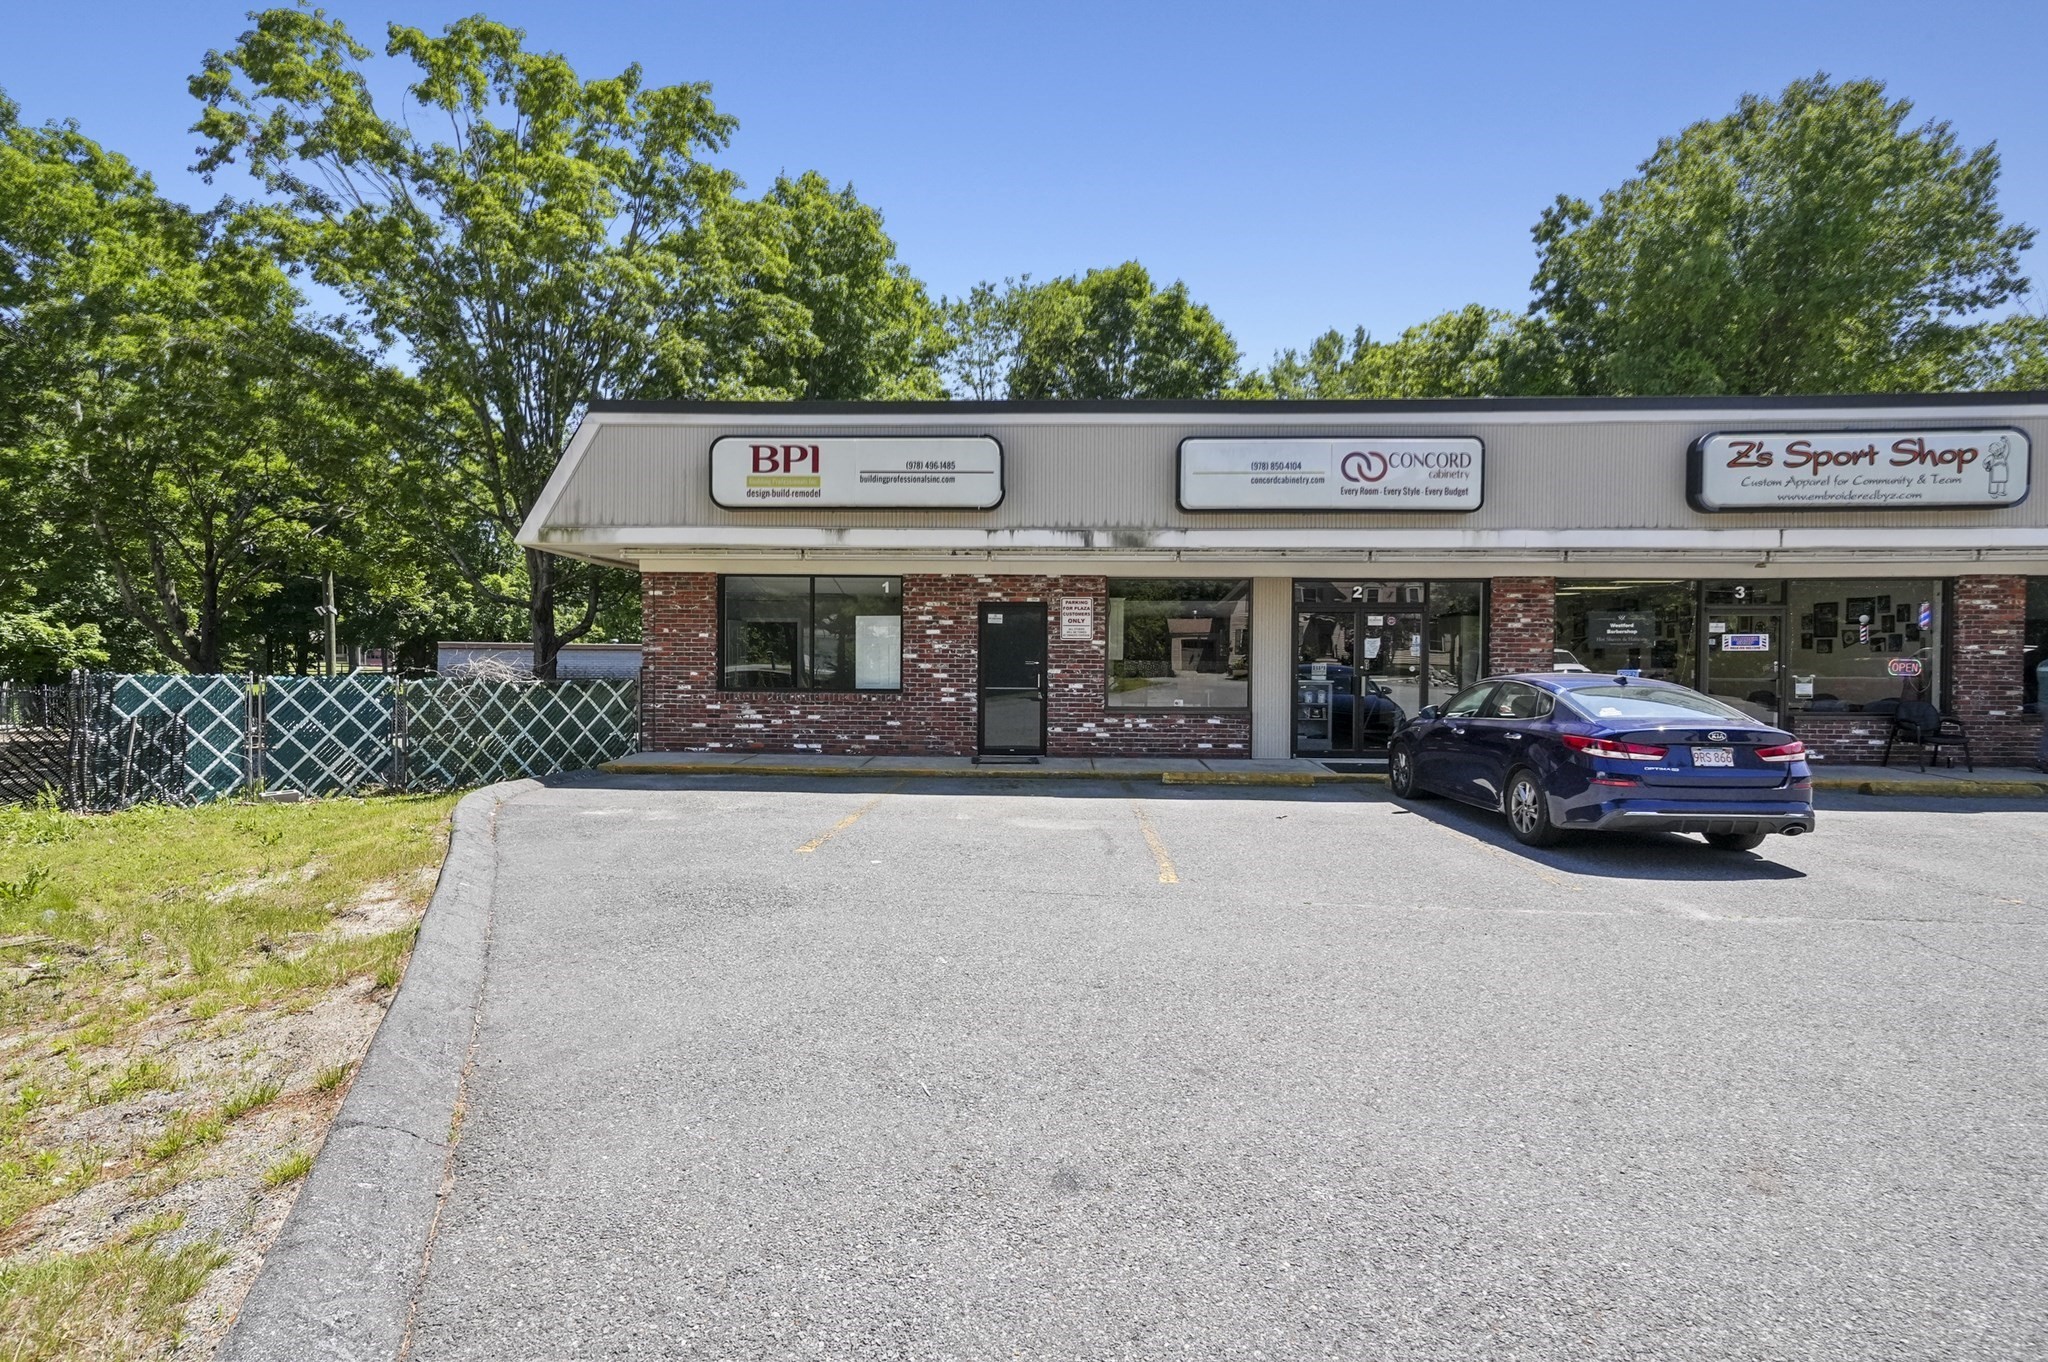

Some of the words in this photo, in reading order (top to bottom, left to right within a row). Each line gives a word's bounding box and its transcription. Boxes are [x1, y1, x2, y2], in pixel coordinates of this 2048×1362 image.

[748, 444, 820, 474] BPI
[1388, 451, 1472, 469] CONCORD
[1726, 440, 1774, 469] Z's
[1783, 440, 1879, 476] Sport
[1889, 437, 1979, 474] Shop
[905, 460, 924, 471] (978)
[1250, 461, 1269, 472] (978)
[859, 475, 956, 485] buildingprofessionalsinc.com
[1250, 475, 1325, 486] concordcabinetry.com
[1428, 469, 1470, 481] cabinetry
[1740, 476, 1782, 488] Custom
[1784, 475, 1831, 489] Apparel
[1833, 474, 1849, 488] for
[1852, 474, 1913, 487] Community
[1916, 475, 1928, 485] &
[1930, 473, 1963, 485] Team
[1340, 486, 1358, 497] Every
[1359, 486, 1379, 496] Room
[1383, 486, 1401, 497] Every
[1402, 486, 1421, 497] Style
[1424, 487, 1443, 498] Every
[1444, 487, 1469, 498] Budget
[1777, 491, 1923, 502] www.embroideredbyz.com
[881, 581, 890, 593] 1
[1352, 586, 1363, 598] 2
[1734, 586, 1746, 599] 3
[1892, 663, 1918, 672] OPEN
